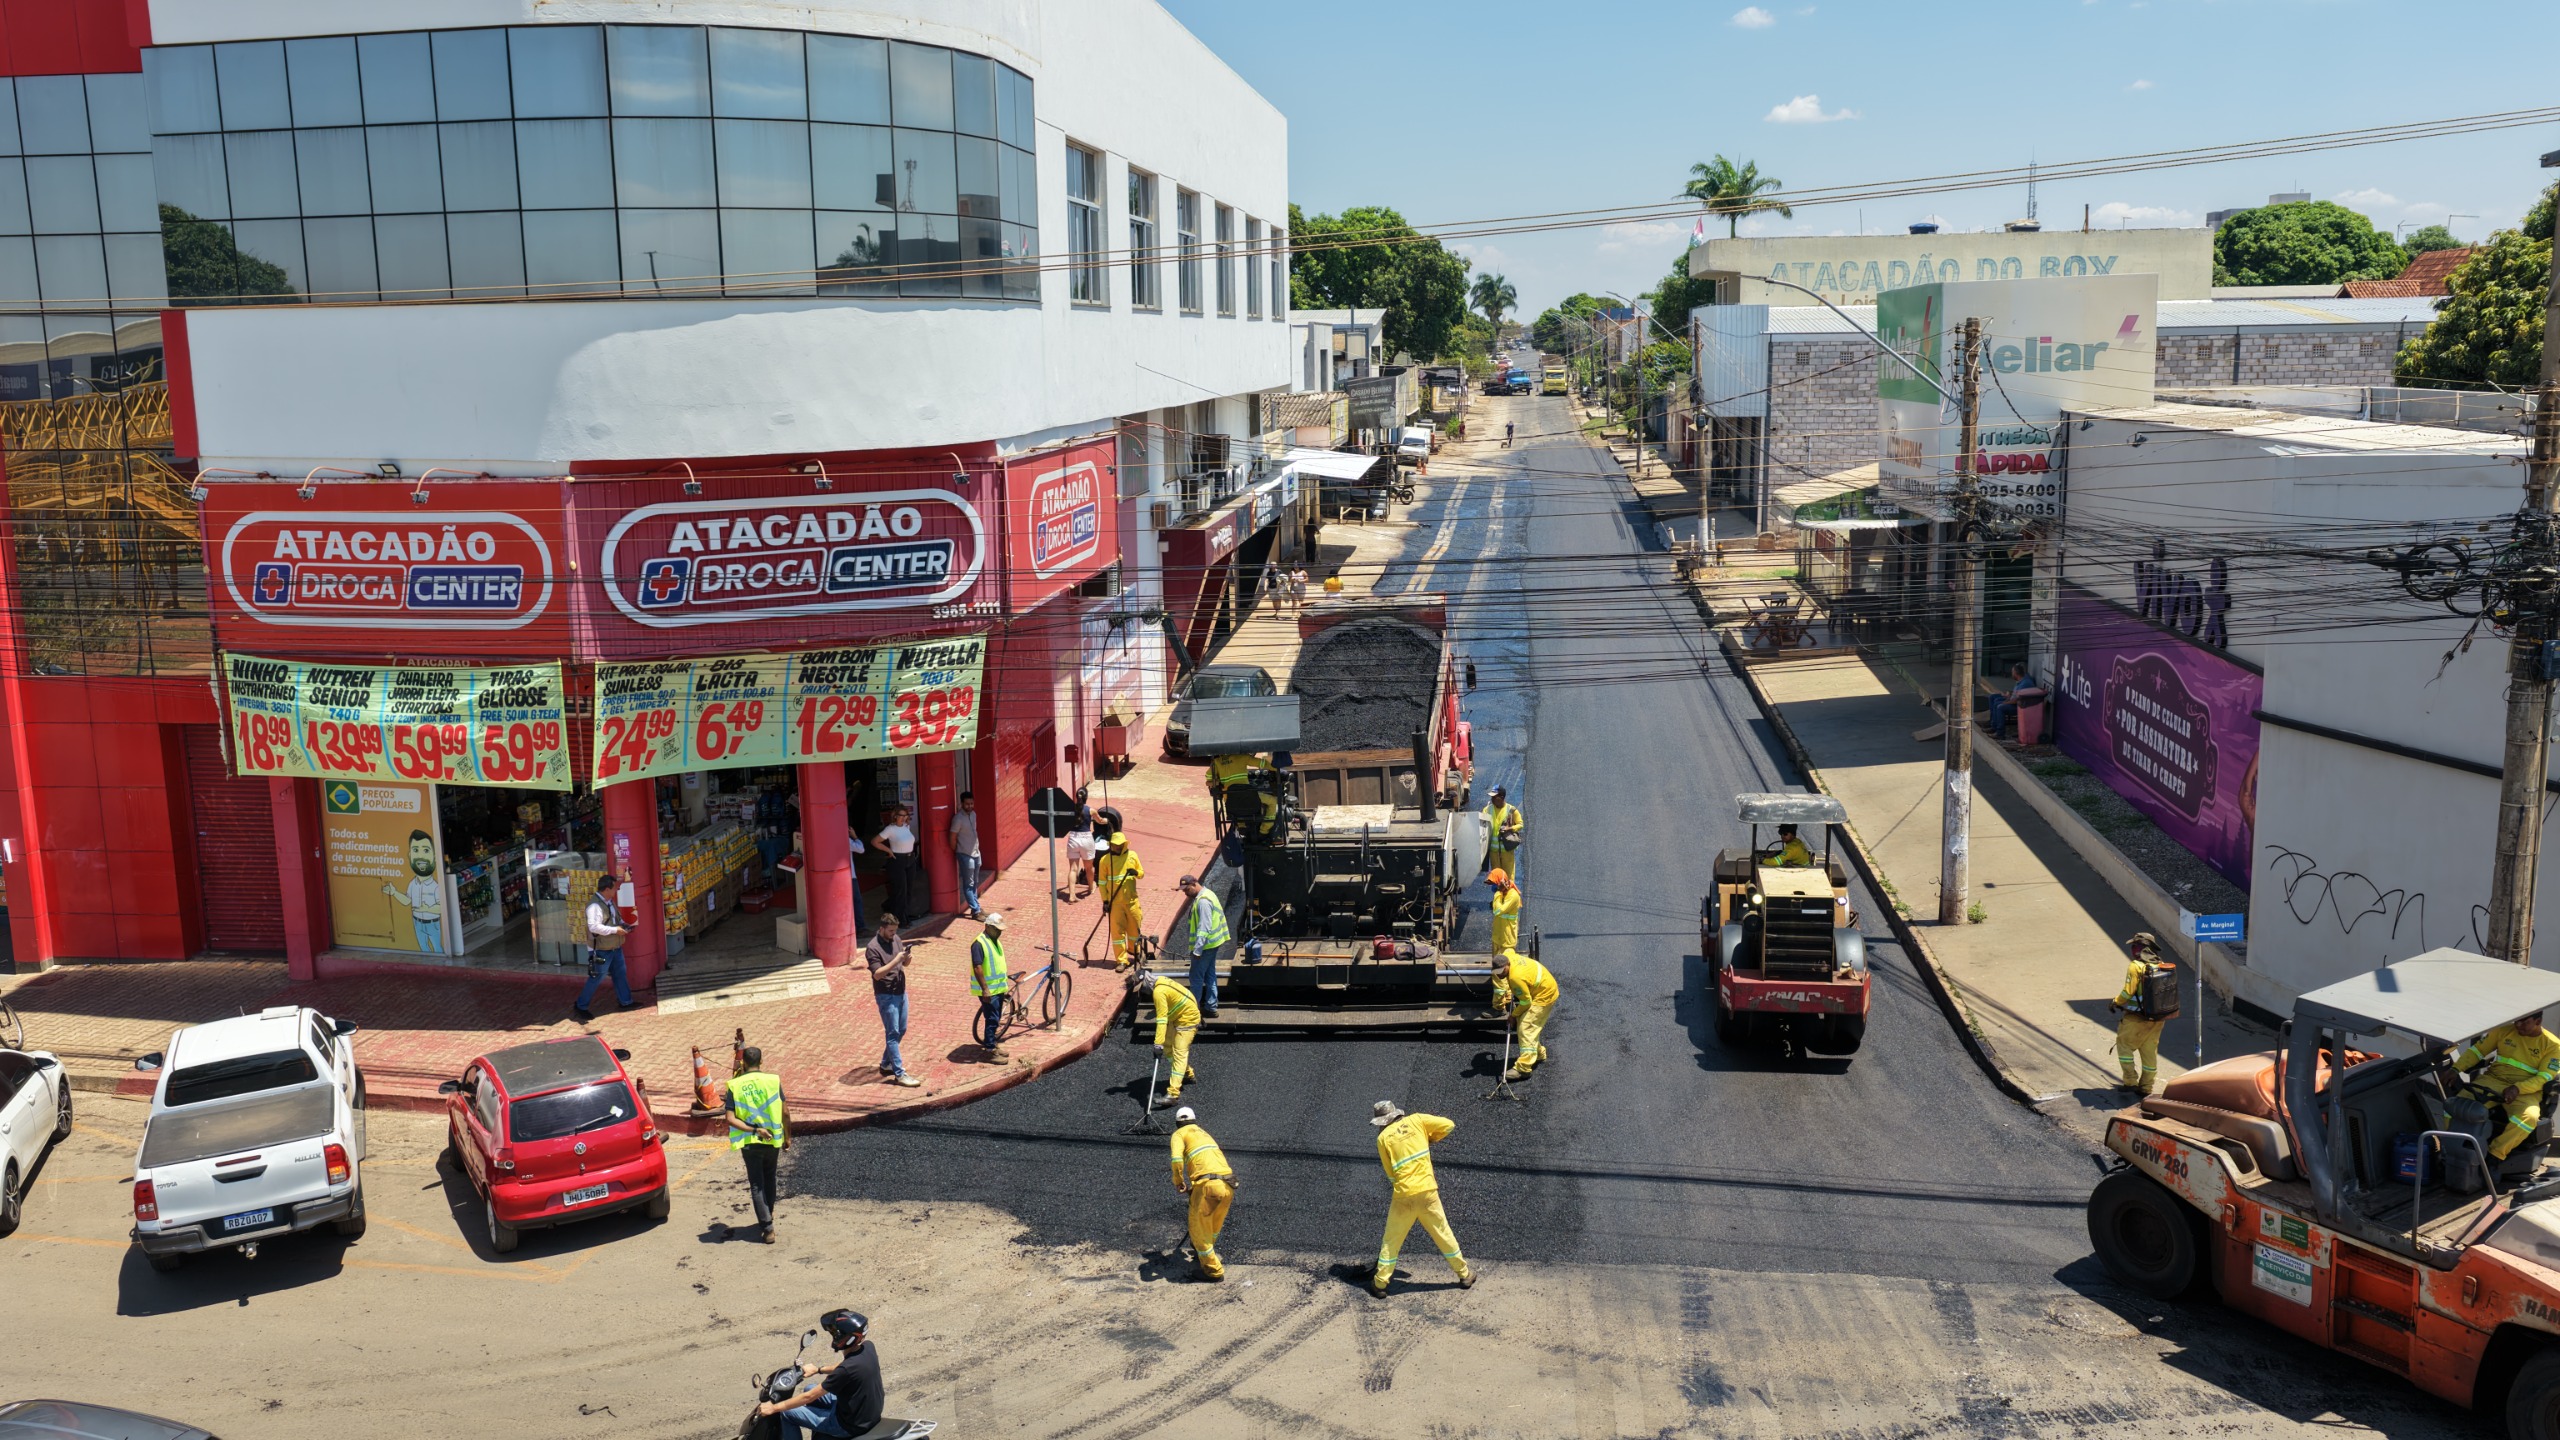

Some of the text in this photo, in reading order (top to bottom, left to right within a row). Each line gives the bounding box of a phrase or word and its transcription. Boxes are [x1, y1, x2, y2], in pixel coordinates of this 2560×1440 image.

[1768, 252, 1960, 292] ATACADÃO
[1041, 473, 1090, 517] ATACADÃO
[668, 503, 923, 554] ATACADÃO
[1048, 507, 1096, 552] DROGA CENTER
[273, 524, 496, 561] ATACADÃO
[701, 549, 947, 594] DROGA CENTER
[300, 573, 518, 602] DROGA CENTER
[932, 601, 1001, 620] 3965-1111
[709, 659, 746, 673] BIS
[896, 642, 980, 671] NUTELLA
[233, 659, 289, 684] NINHO
[306, 668, 376, 689] NUTREN
[396, 671, 454, 687] CHALEIRA
[490, 670, 534, 687] TIRAS
[597, 666, 618, 682] KIT
[650, 662, 693, 674] SOLAR
[920, 671, 943, 686] 700
[602, 676, 663, 697] SUNLESS
[695, 671, 759, 692] LACTA
[800, 684, 831, 695] CAIXA
[2069, 660, 2092, 709] Lite
[309, 687, 371, 709] SENIOR
[387, 688, 425, 701] JARRA
[478, 686, 548, 709] GLICOSE
[628, 691, 654, 702] FACIAL
[713, 689, 740, 701] LEITE
[329, 707, 349, 721] 740
[391, 701, 455, 714] STARTOOLS
[629, 699, 670, 713] LIMPEZA
[2126, 686, 2191, 739] O PLANO DE CELULAR
[420, 714, 437, 723] INOX
[439, 714, 461, 723] PRETA
[480, 710, 502, 722] FREE
[2121, 708, 2193, 774] POR ASSINATURA
[2122, 741, 2187, 798] DE TIRAR O CHAPÉU
[362, 789, 395, 802] PREÇOS
[363, 799, 414, 810] POPULARES
[330, 828, 369, 840] Todos os
[331, 840, 400, 854] medicamentos
[332, 851, 405, 866] de uso contínuo
[333, 864, 404, 878] e não contínuo.
[2211, 921, 2235, 929] Marginal
[2131, 1138, 2189, 1179] GRW 280
[156, 1181, 178, 1190] TOYOTA
[2265, 1262, 2294, 1277] SERVIÇO
[2295, 1274, 2306, 1282] DA
